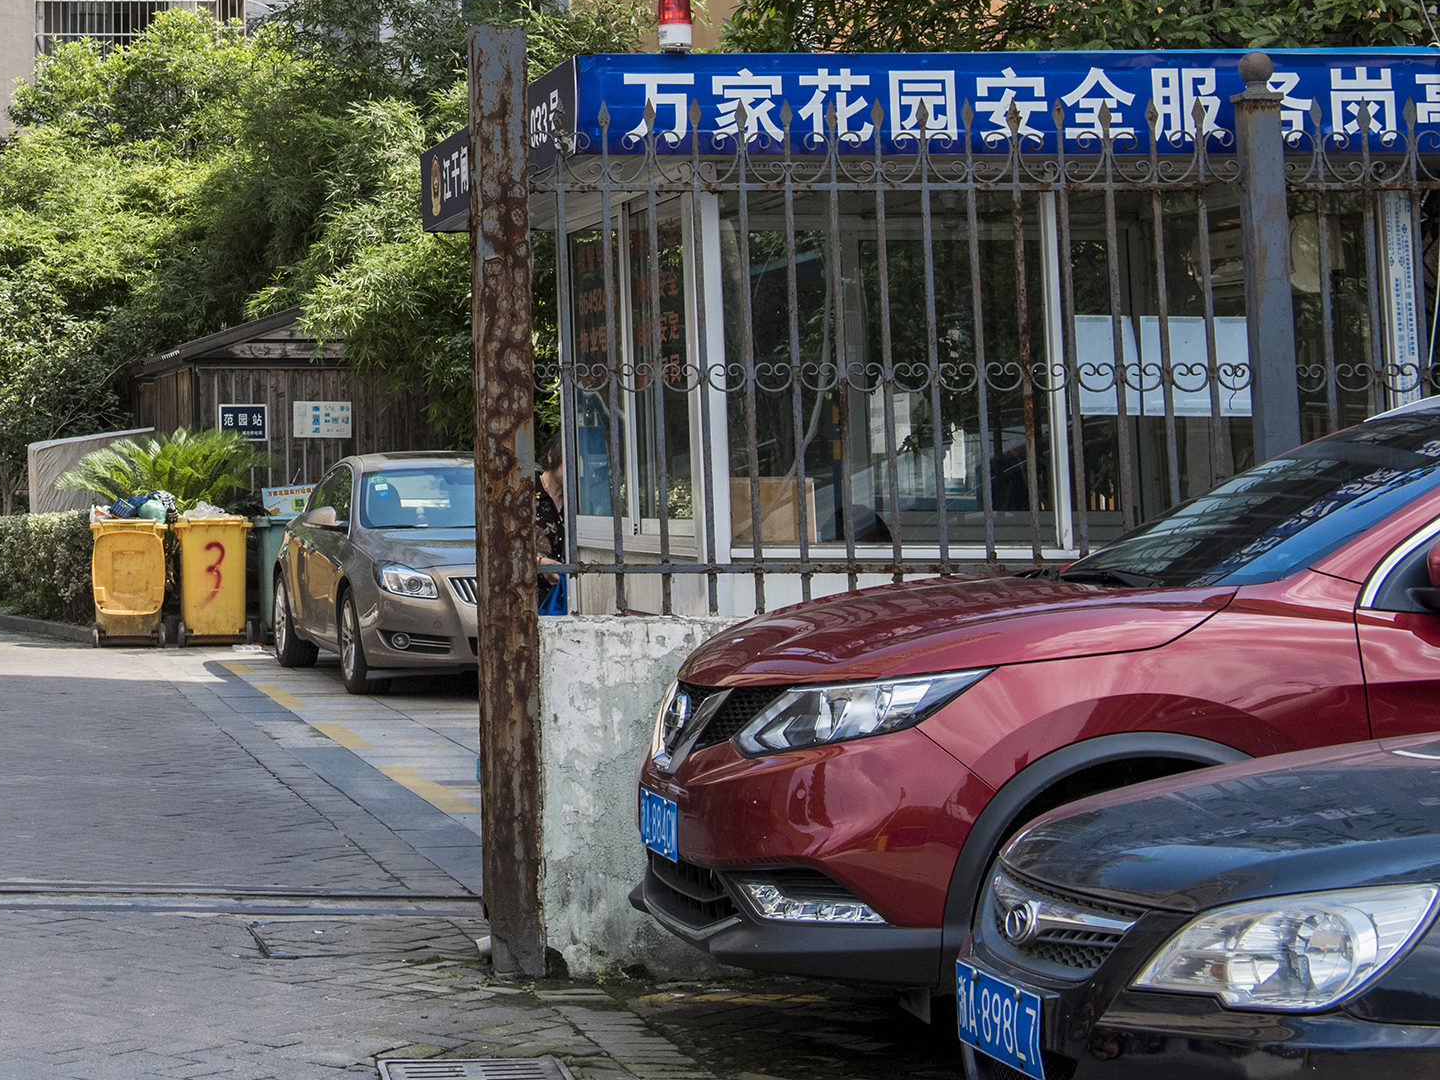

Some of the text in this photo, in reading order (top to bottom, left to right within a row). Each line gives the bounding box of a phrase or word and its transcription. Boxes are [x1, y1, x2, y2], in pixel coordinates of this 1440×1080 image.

[224, 413, 262, 426] 范园站
[205, 541, 226, 609] 3
